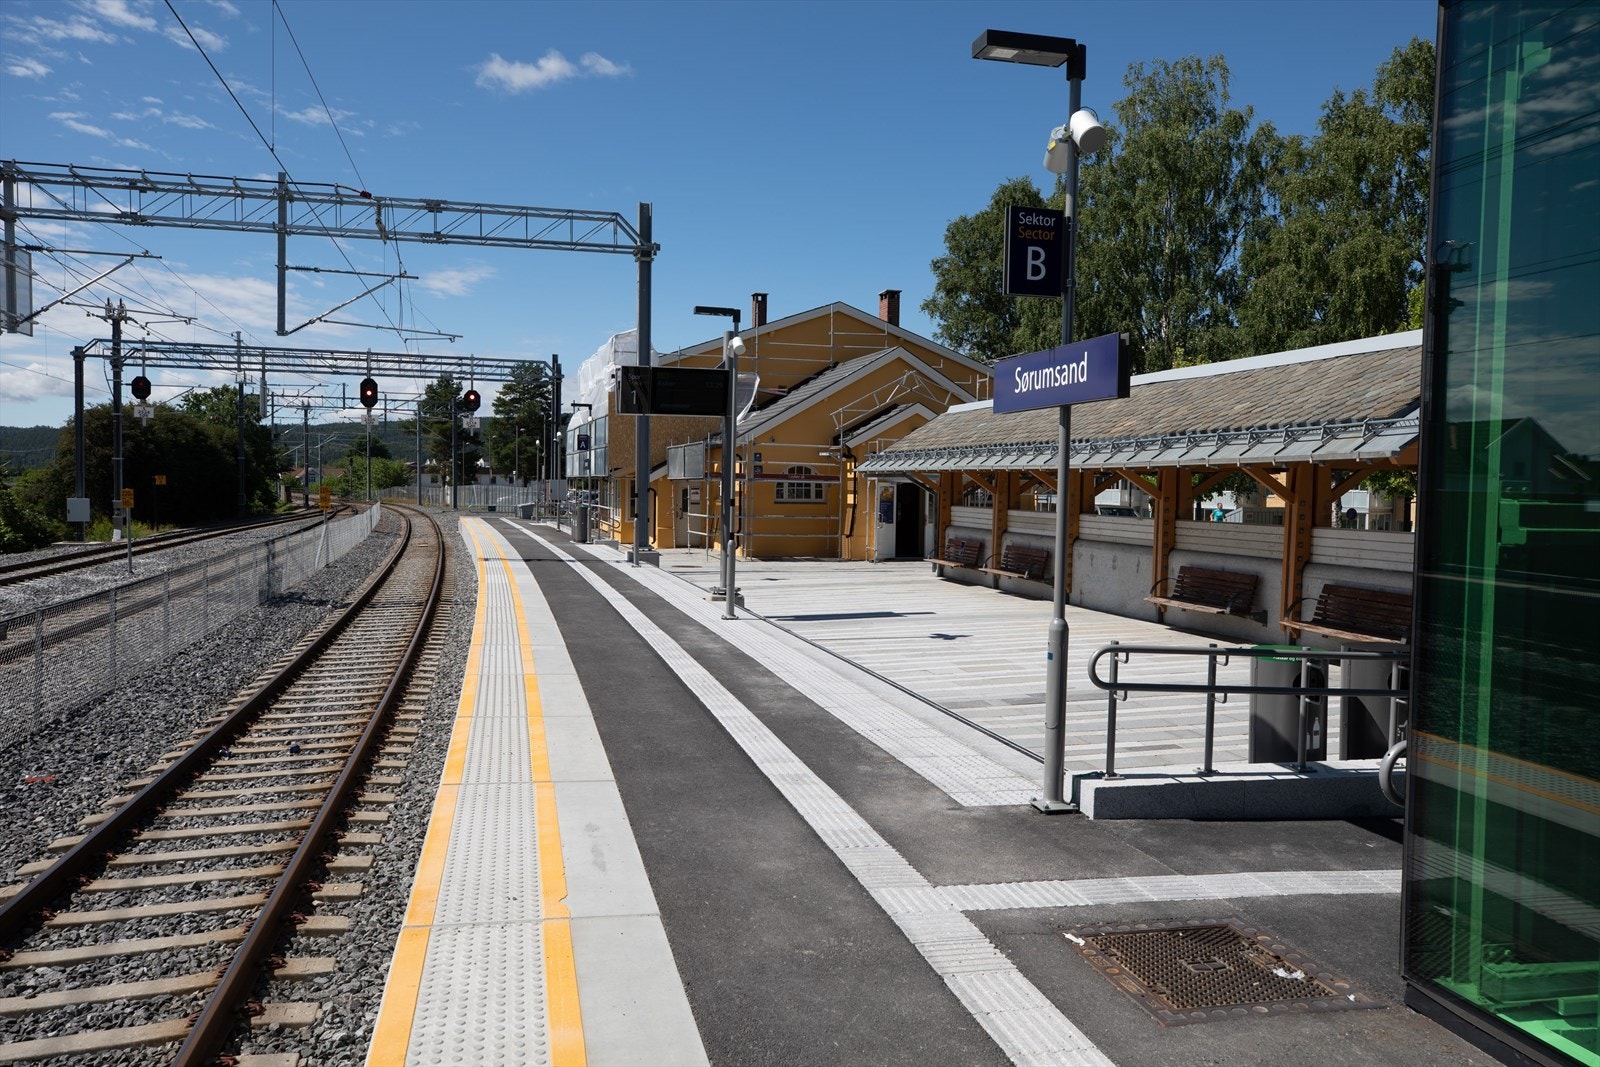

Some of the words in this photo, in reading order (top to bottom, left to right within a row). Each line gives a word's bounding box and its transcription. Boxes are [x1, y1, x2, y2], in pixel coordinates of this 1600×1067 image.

[1018, 211, 1056, 227] Sektor
[1018, 226, 1055, 241] Sector
[1026, 246, 1046, 281] B
[1014, 351, 1088, 394] Sørumsand
[630, 390, 637, 405] 1
[579, 441, 586, 449] A
